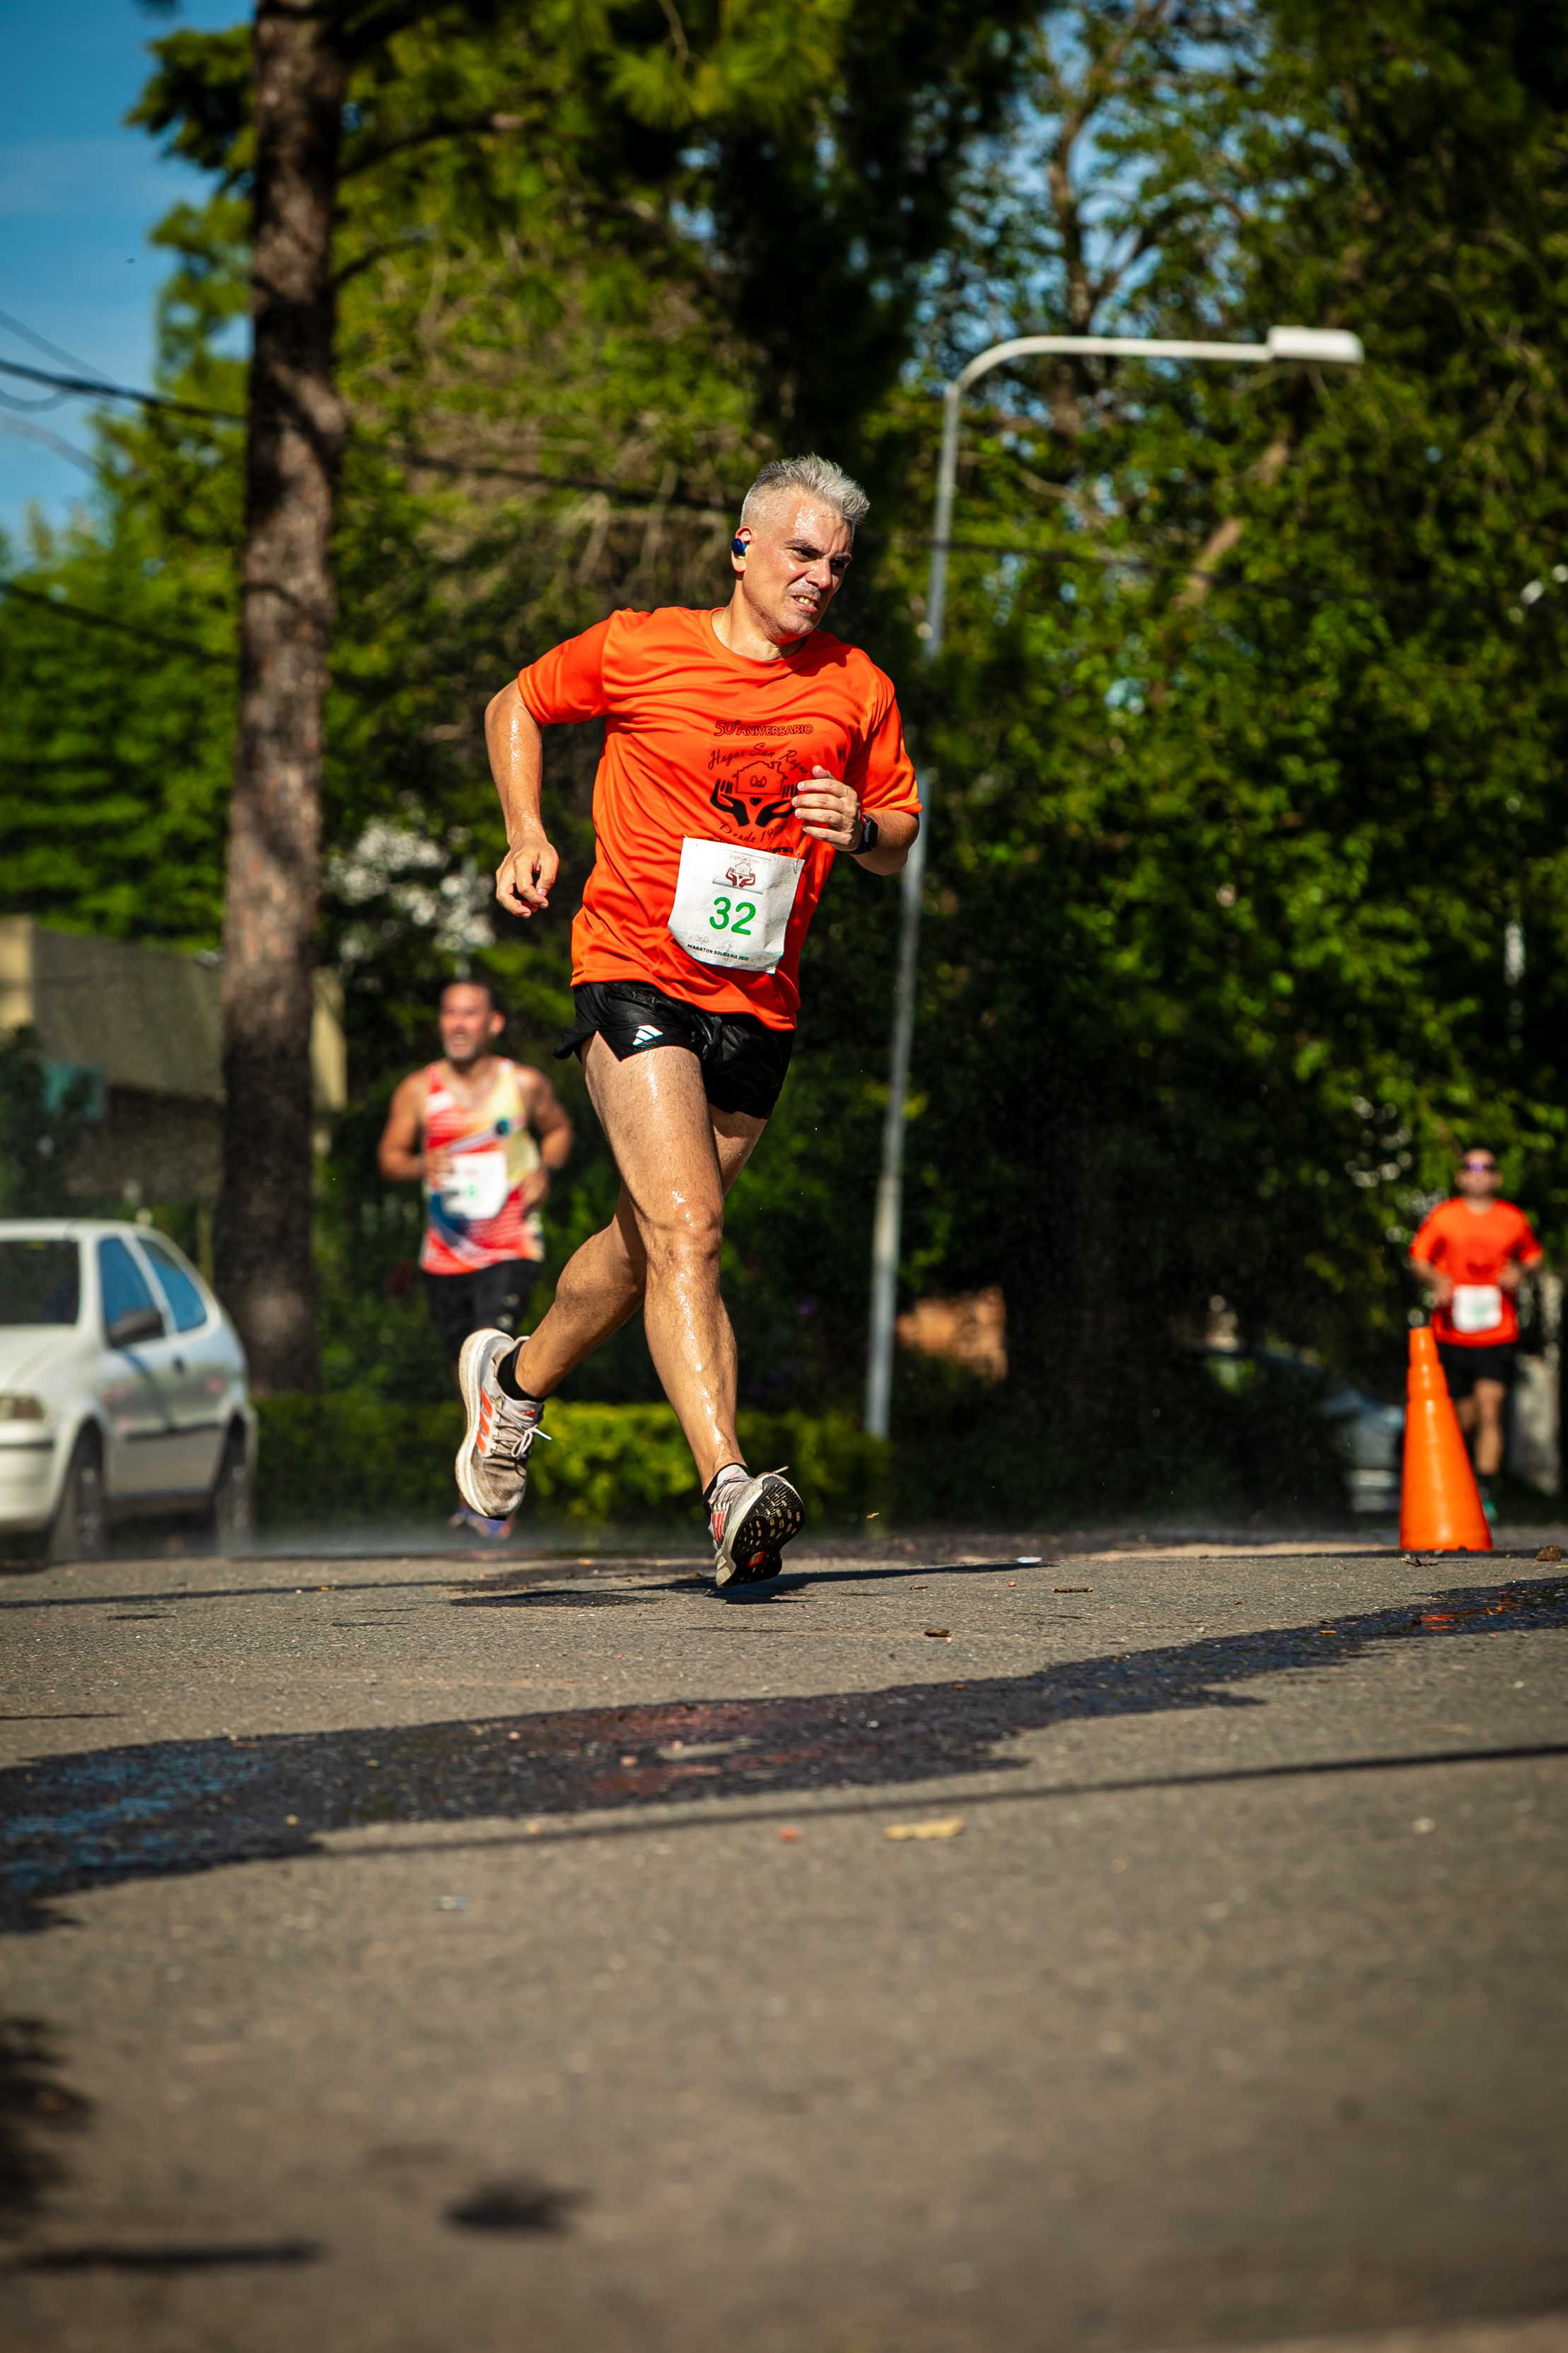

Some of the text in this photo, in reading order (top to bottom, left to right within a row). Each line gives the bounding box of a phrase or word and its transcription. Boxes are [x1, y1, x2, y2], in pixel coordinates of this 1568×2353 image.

[736, 723, 813, 736] ANIVERSARIO
[708, 742, 808, 774] Hogar San Roque
[720, 821, 756, 843] Desde
[709, 896, 756, 936] 32
[687, 944, 713, 954] MARATON
[714, 950, 738, 959] SOLIDARIA
